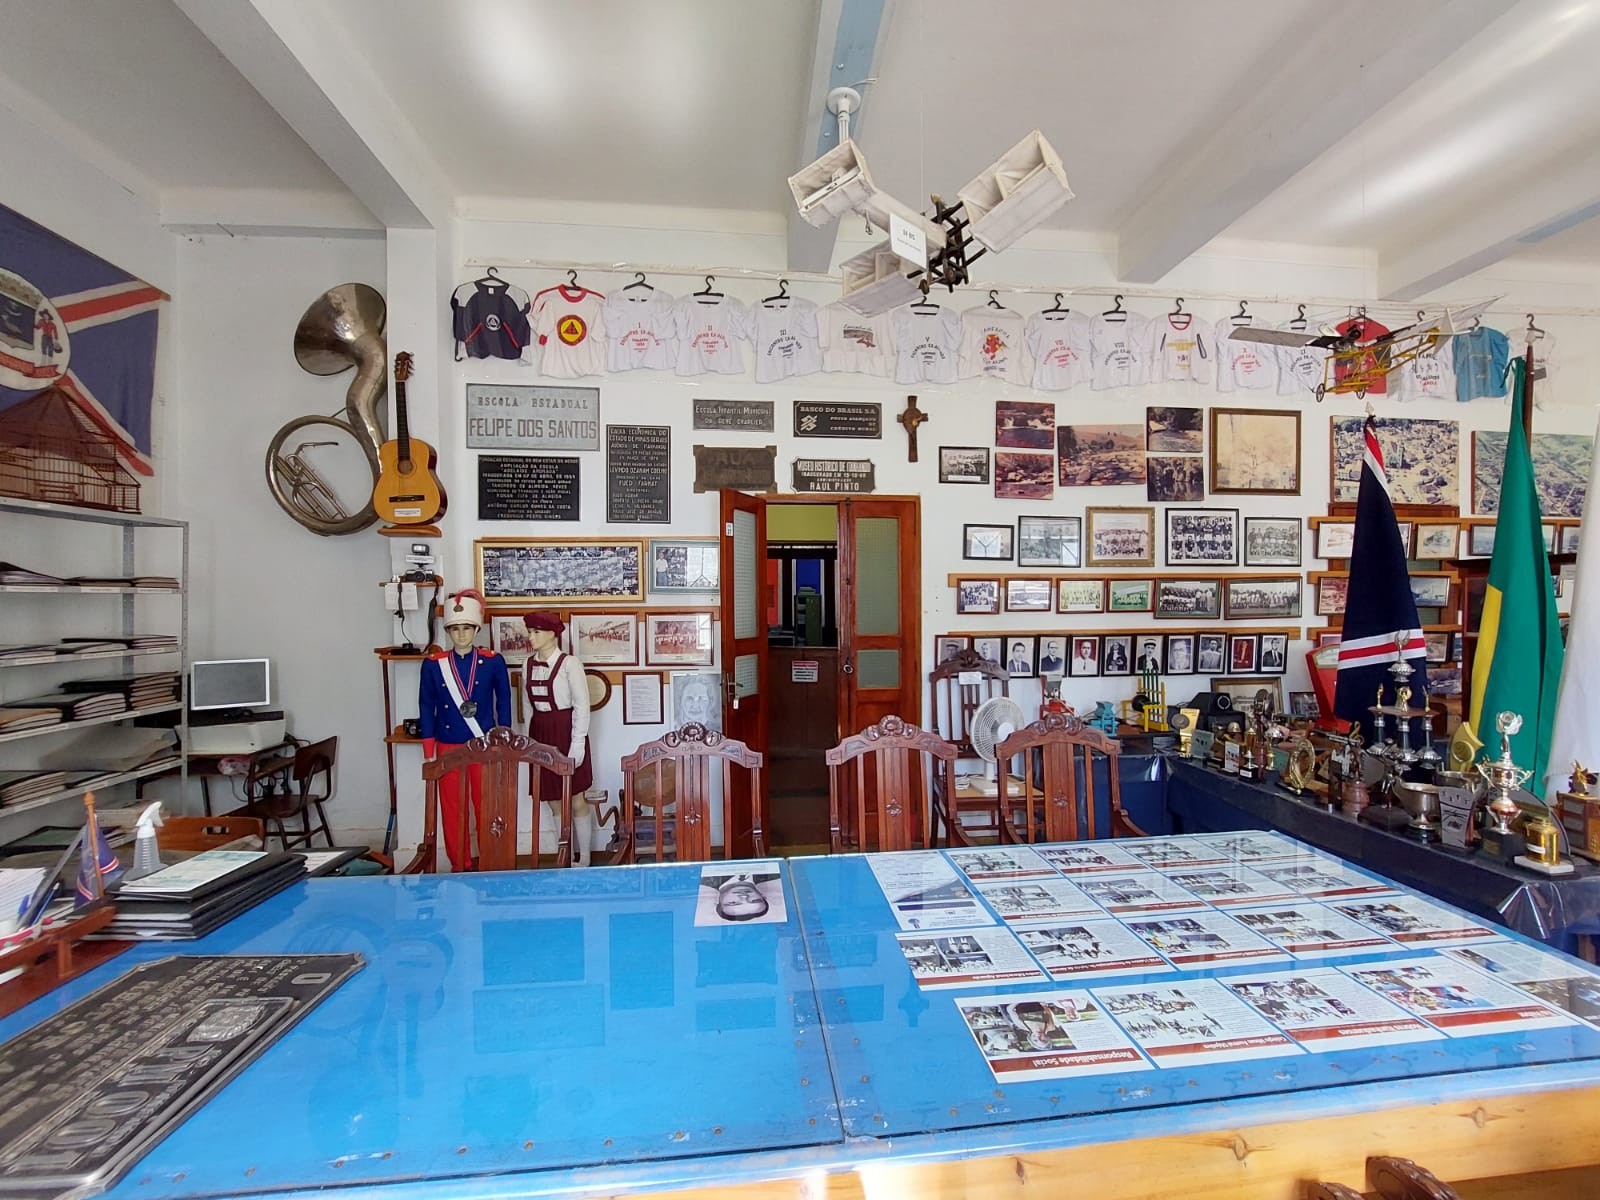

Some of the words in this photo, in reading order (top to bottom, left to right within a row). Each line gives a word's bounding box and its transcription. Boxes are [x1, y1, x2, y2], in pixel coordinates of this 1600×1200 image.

[477, 396, 519, 407] ESCOLA
[531, 398, 588, 409] ESTADUAL
[469, 418, 513, 437] FELIPE
[517, 419, 544, 438] DOS
[548, 420, 597, 439] SANTOS
[809, 481, 832, 491] RAUL
[834, 482, 860, 491] PINTO
[1032, 1057, 1059, 1068] Social
[1059, 1050, 1135, 1065] Responsabilidade
